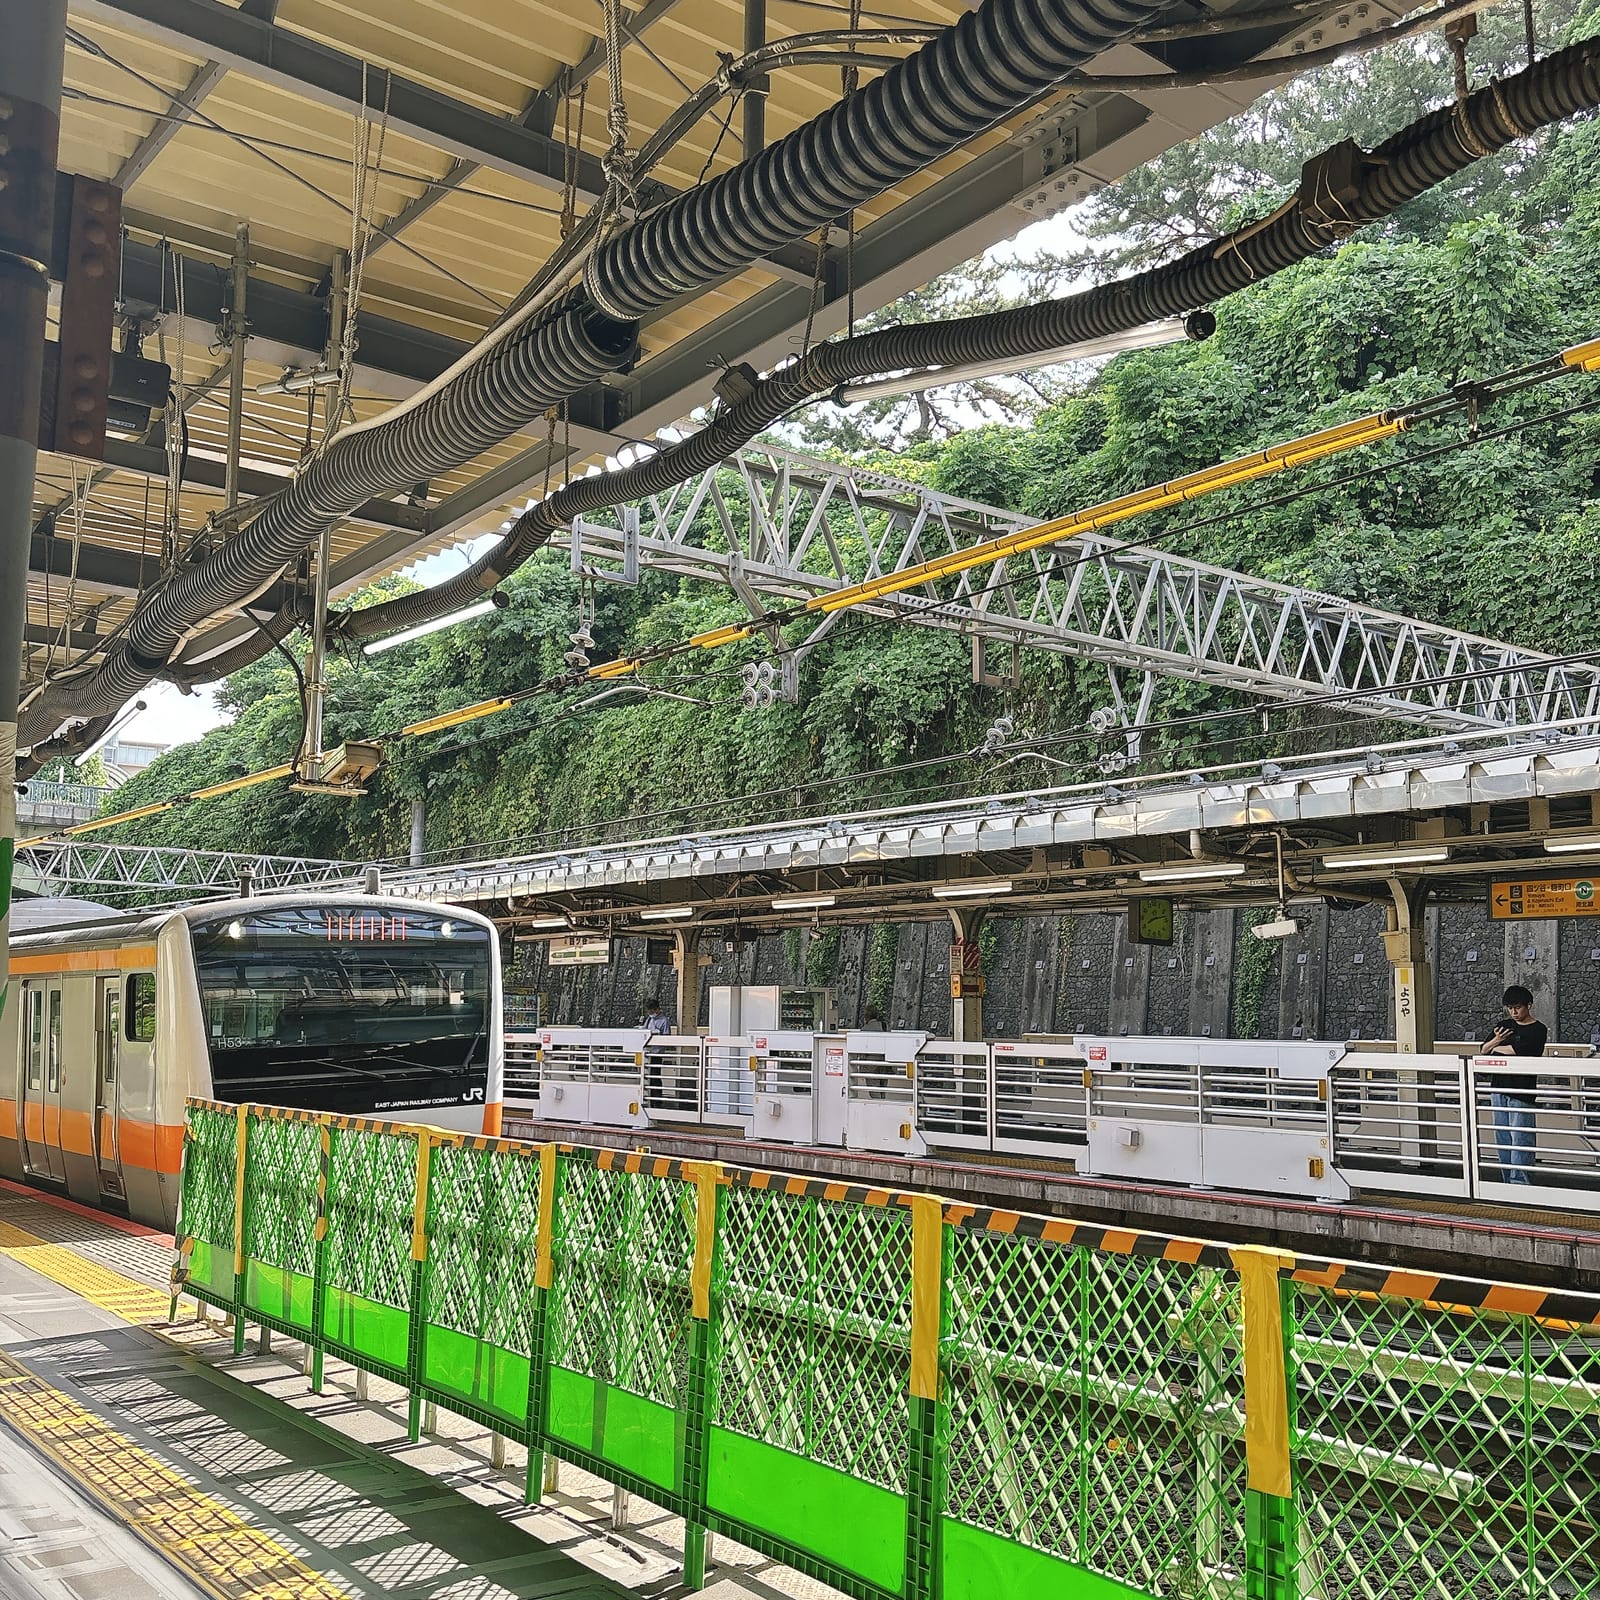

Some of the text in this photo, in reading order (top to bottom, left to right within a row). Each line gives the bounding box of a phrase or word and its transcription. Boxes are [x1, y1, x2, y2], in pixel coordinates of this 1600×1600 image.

[1400, 987, 1410, 1017] よつや
[218, 1036, 242, 1048] H53
[462, 1088, 484, 1101] JR
[374, 1101, 391, 1109] EAST
[431, 1096, 459, 1104] COMPANY
